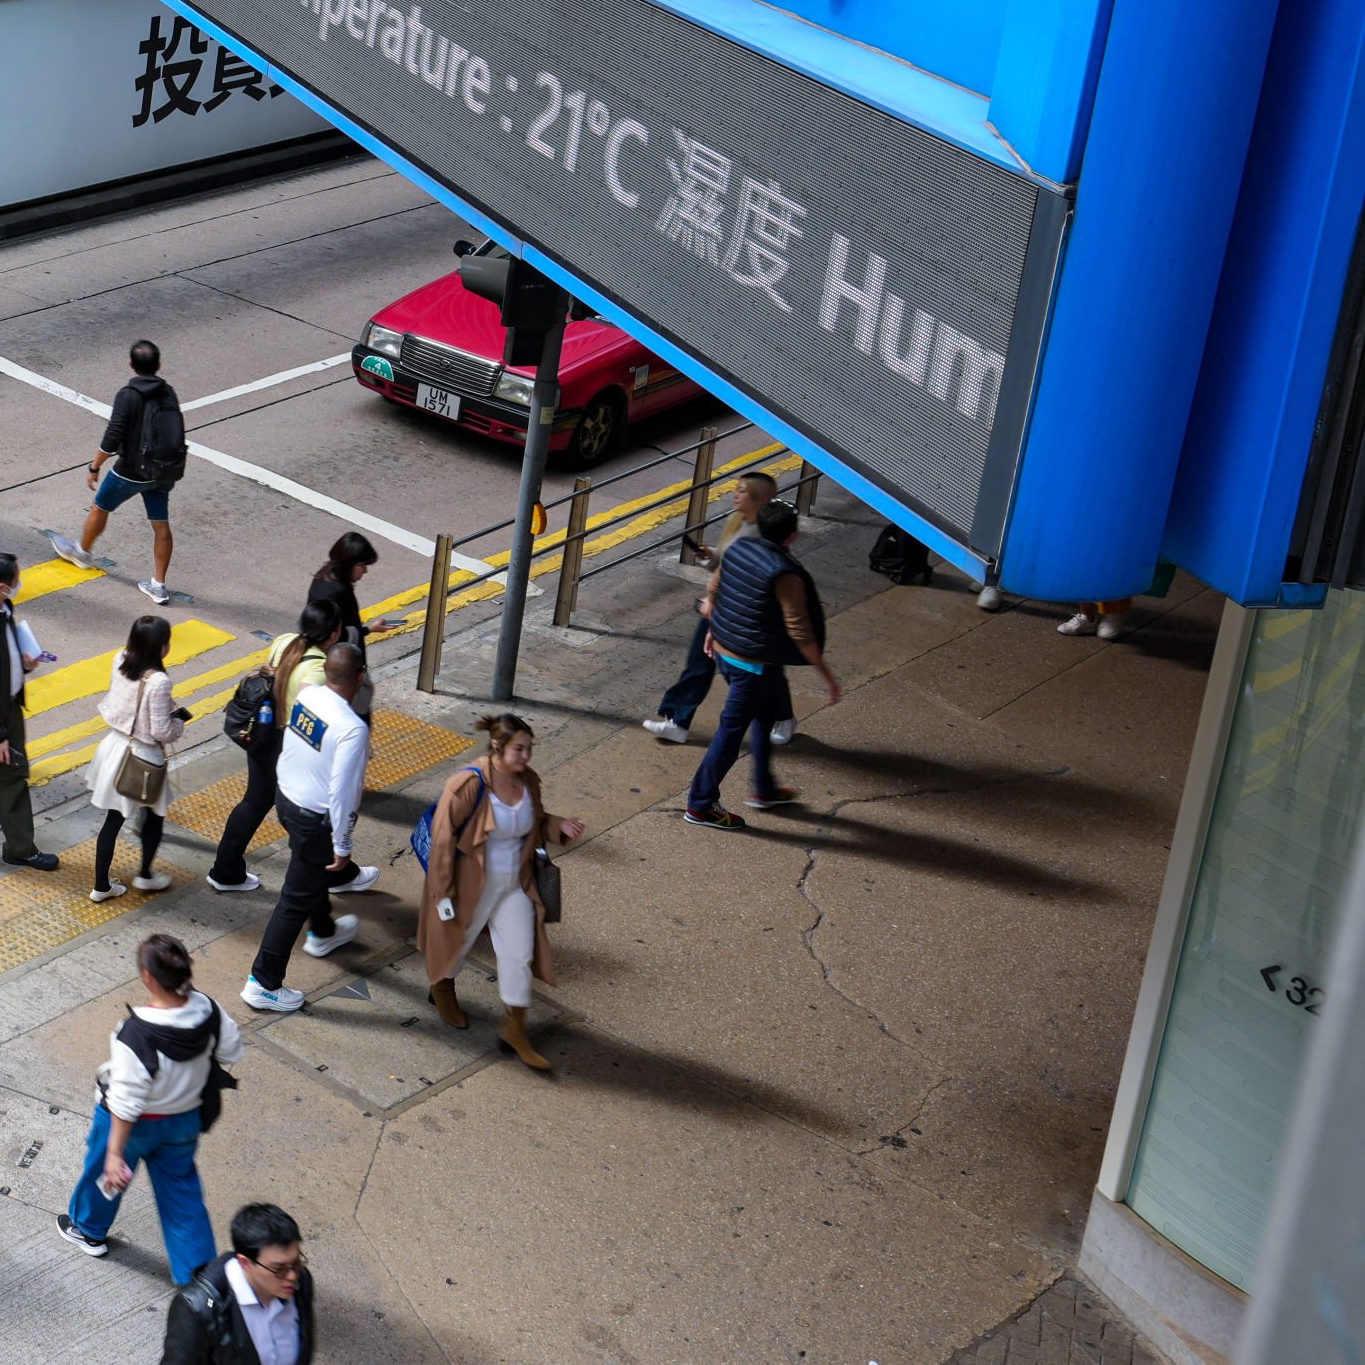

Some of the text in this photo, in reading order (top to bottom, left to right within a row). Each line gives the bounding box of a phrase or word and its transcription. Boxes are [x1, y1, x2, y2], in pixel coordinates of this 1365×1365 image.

[818, 232, 1006, 431] Hum
[374, 362, 381, 370] 4
[429, 387, 448, 403] UM
[423, 398, 451, 417] 1571
[296, 713, 315, 736] PFG
